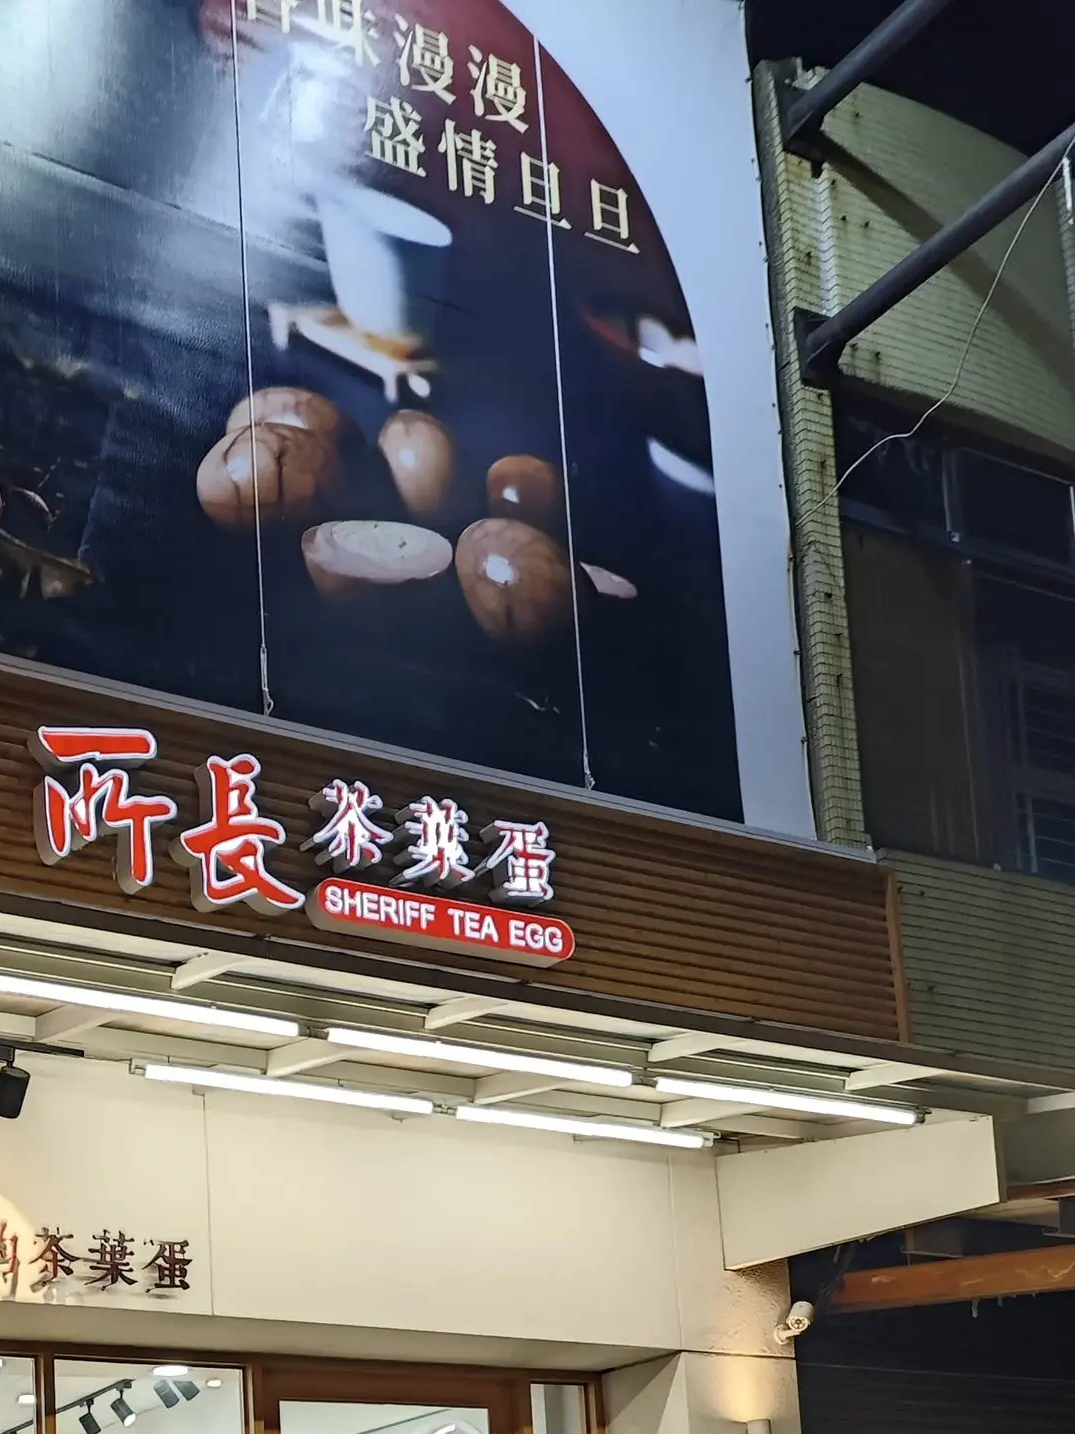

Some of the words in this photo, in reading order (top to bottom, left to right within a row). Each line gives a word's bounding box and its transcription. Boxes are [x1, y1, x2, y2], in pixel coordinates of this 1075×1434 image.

[364, 96, 640, 254] 盛情旦旦
[35, 725, 306, 908] 所長
[313, 779, 556, 901] 茶葉蛋
[324, 884, 436, 930] SHERIFF
[447, 907, 499, 943] TEA
[509, 917, 564, 953] EGG
